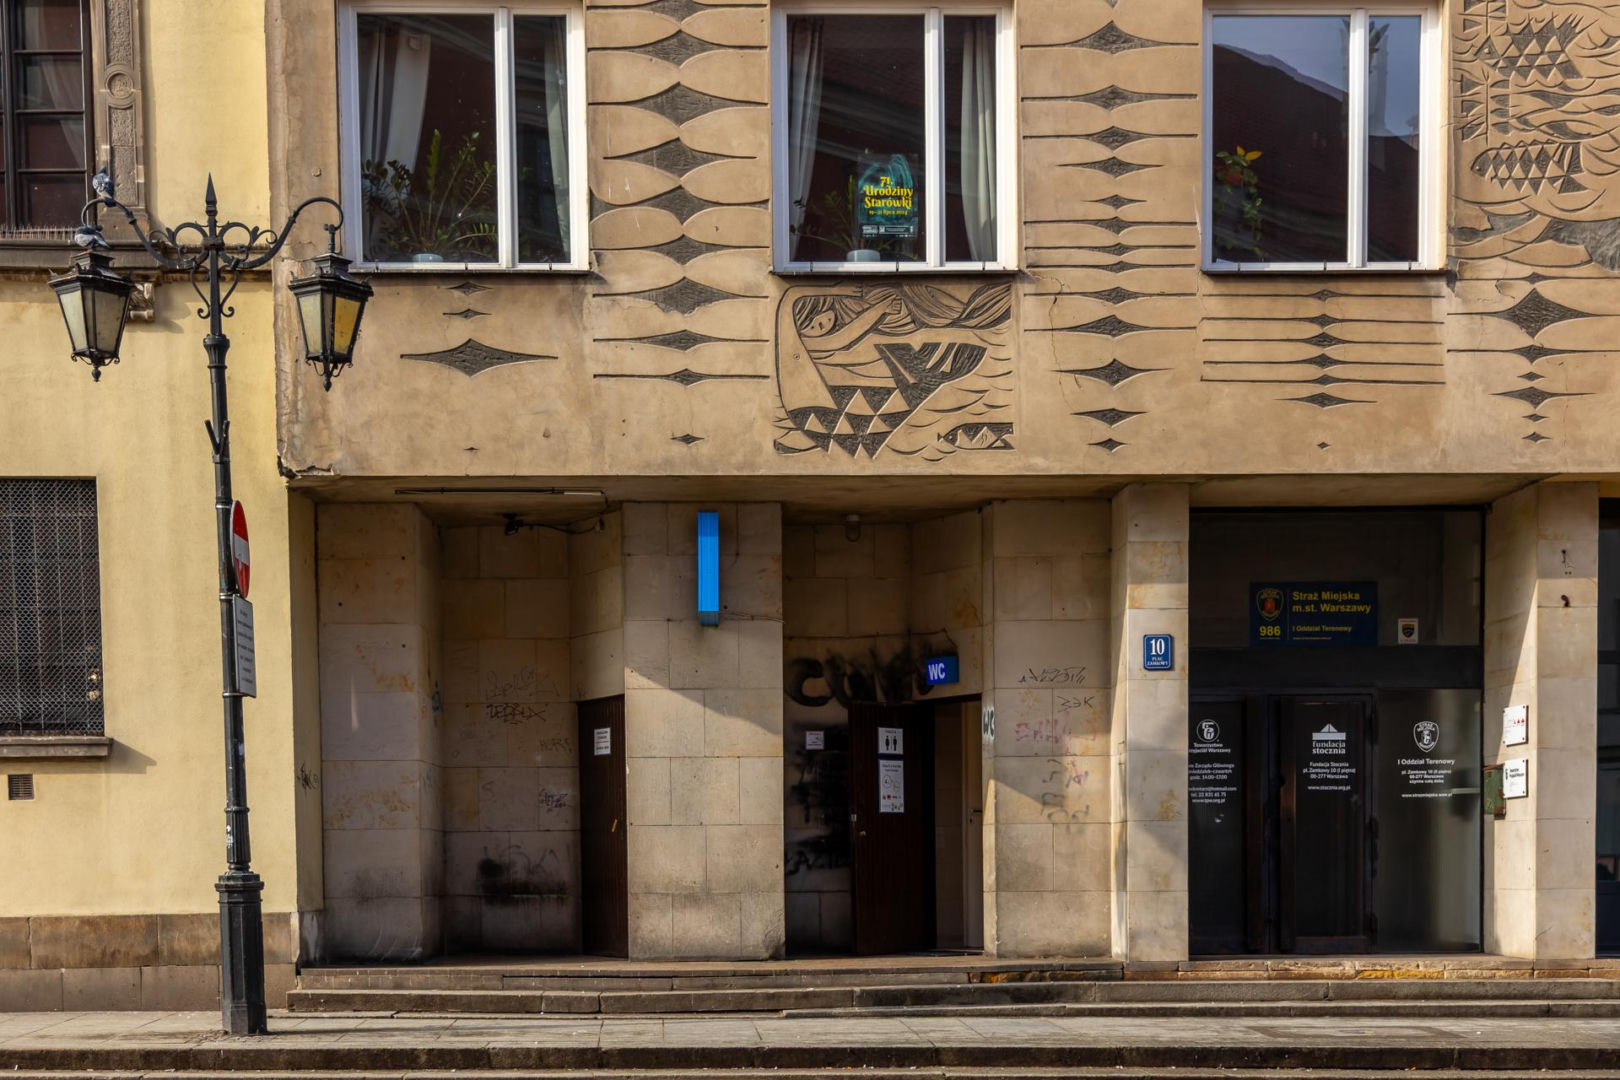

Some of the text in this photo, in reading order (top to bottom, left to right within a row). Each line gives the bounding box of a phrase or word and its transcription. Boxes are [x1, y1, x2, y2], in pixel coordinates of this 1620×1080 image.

[880, 176, 894, 187] 71.
[864, 185, 913, 197] Urodziny
[864, 197, 912, 210] Starówki
[1292, 592, 1360, 601] Straż Miejska
[1292, 604, 1371, 614] m.st. Warszawy
[1260, 626, 1280, 636] 986
[1150, 638, 1165, 655] 10
[929, 663, 946, 681] WC
